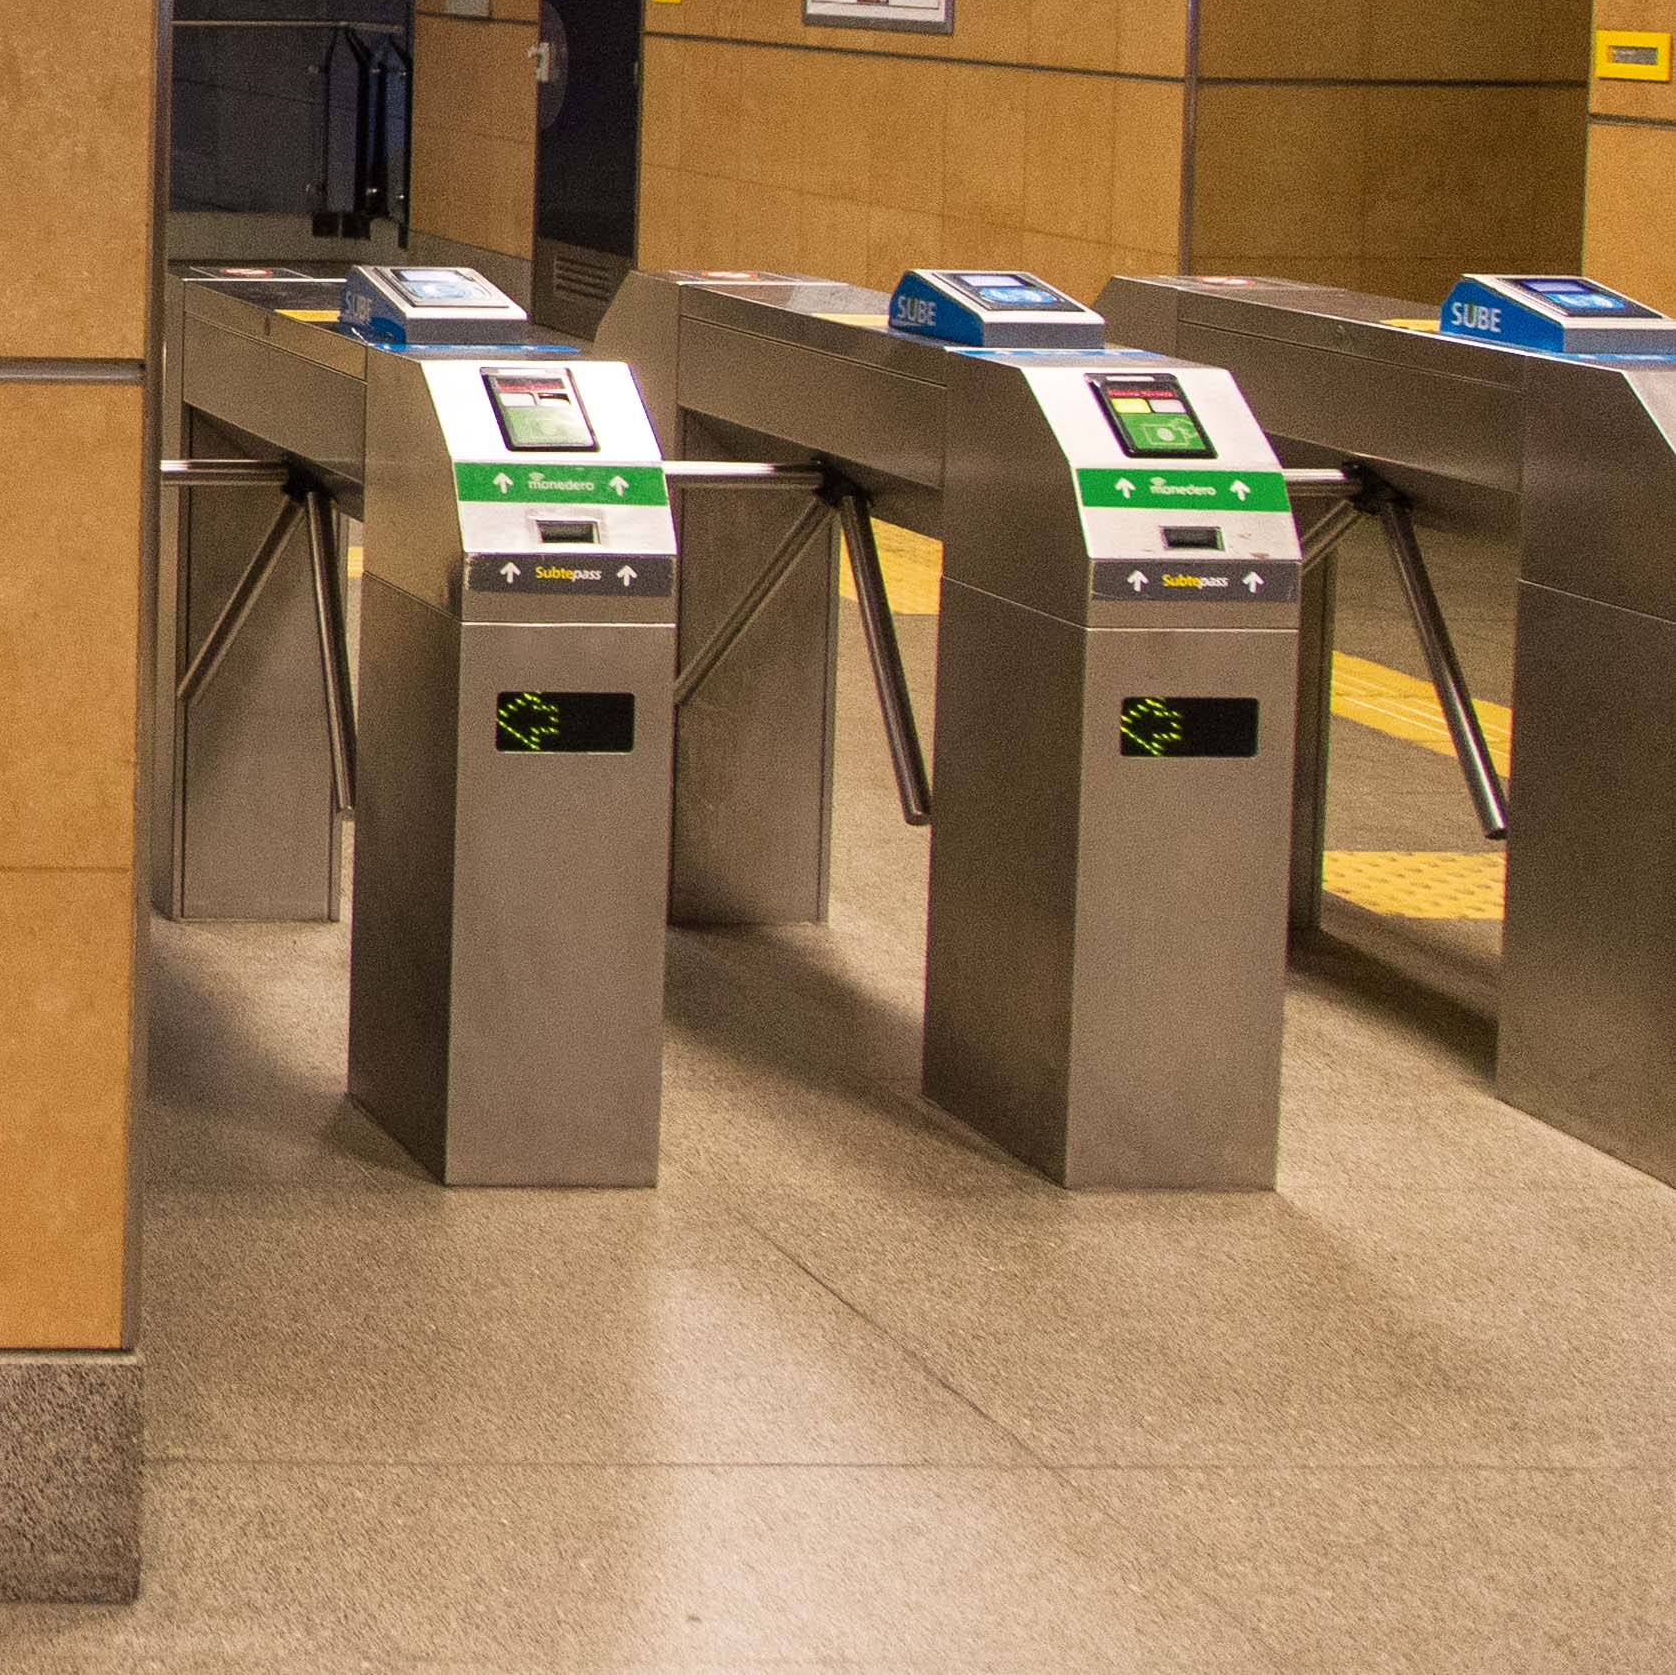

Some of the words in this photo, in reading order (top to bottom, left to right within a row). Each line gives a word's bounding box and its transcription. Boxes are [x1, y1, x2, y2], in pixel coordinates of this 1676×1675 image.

[896, 295, 937, 326] SUBE
[1450, 301, 1502, 333] SUBE
[528, 477, 595, 492] monedero
[1149, 484, 1217, 497] monedero
[534, 566, 602, 582] Subtepass
[1161, 573, 1230, 589] Subtepass
